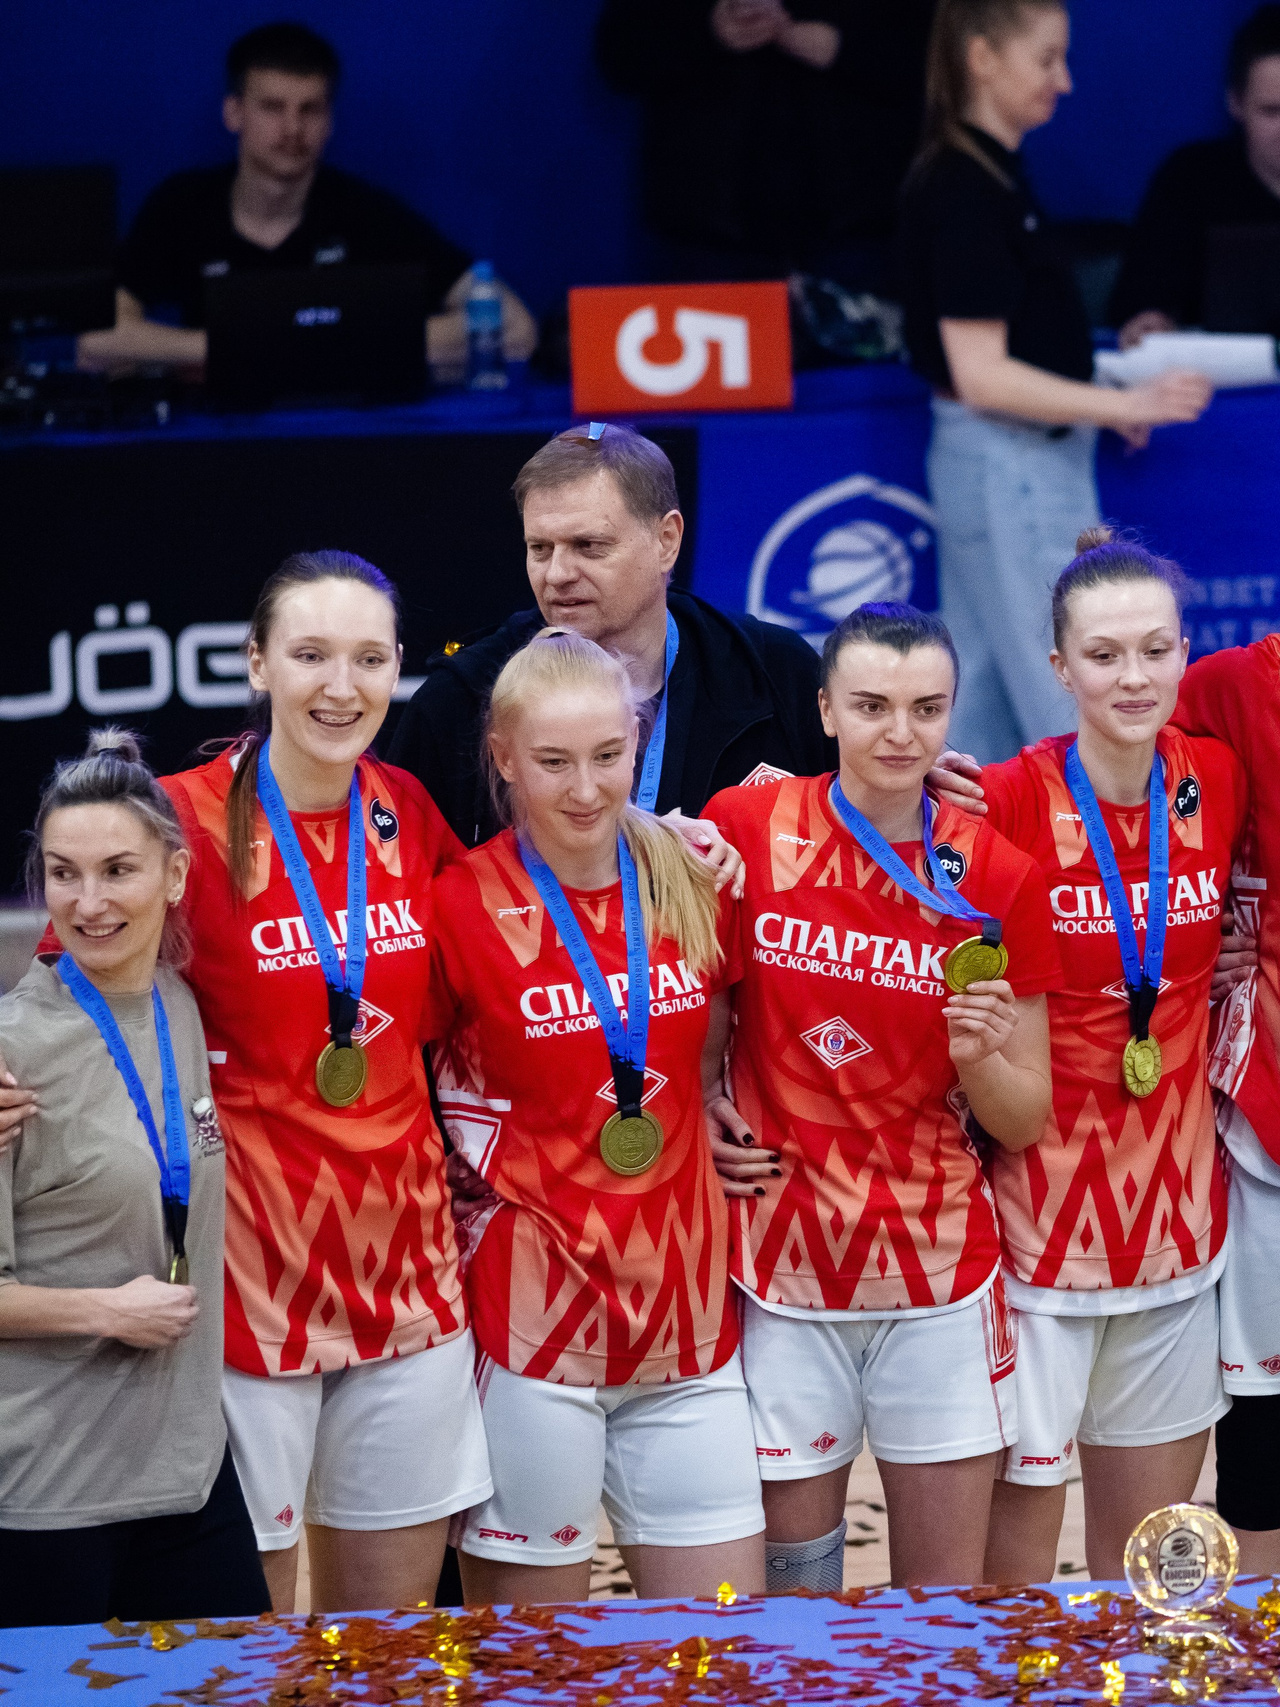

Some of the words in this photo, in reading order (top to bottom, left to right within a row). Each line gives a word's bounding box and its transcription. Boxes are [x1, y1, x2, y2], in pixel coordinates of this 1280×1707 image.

[615, 305, 750, 396] 5
[940, 858, 961, 874] ФБ
[1049, 867, 1220, 918] СПРАК
[1052, 917, 1149, 935] МОСКОВКА
[1166, 903, 1221, 927] ОБЛАСТЬ
[257, 946, 369, 973] МОСКОК
[373, 933, 426, 955] ОБЛАСТЬ
[754, 912, 949, 980] СПАРТАК
[753, 947, 865, 983] МОСКОВСКАЯ
[870, 971, 945, 997] ОБЛАСТЬ
[525, 1010, 629, 1039] МОСКОВА
[649, 992, 706, 1017] ОБЛАСТЬ
